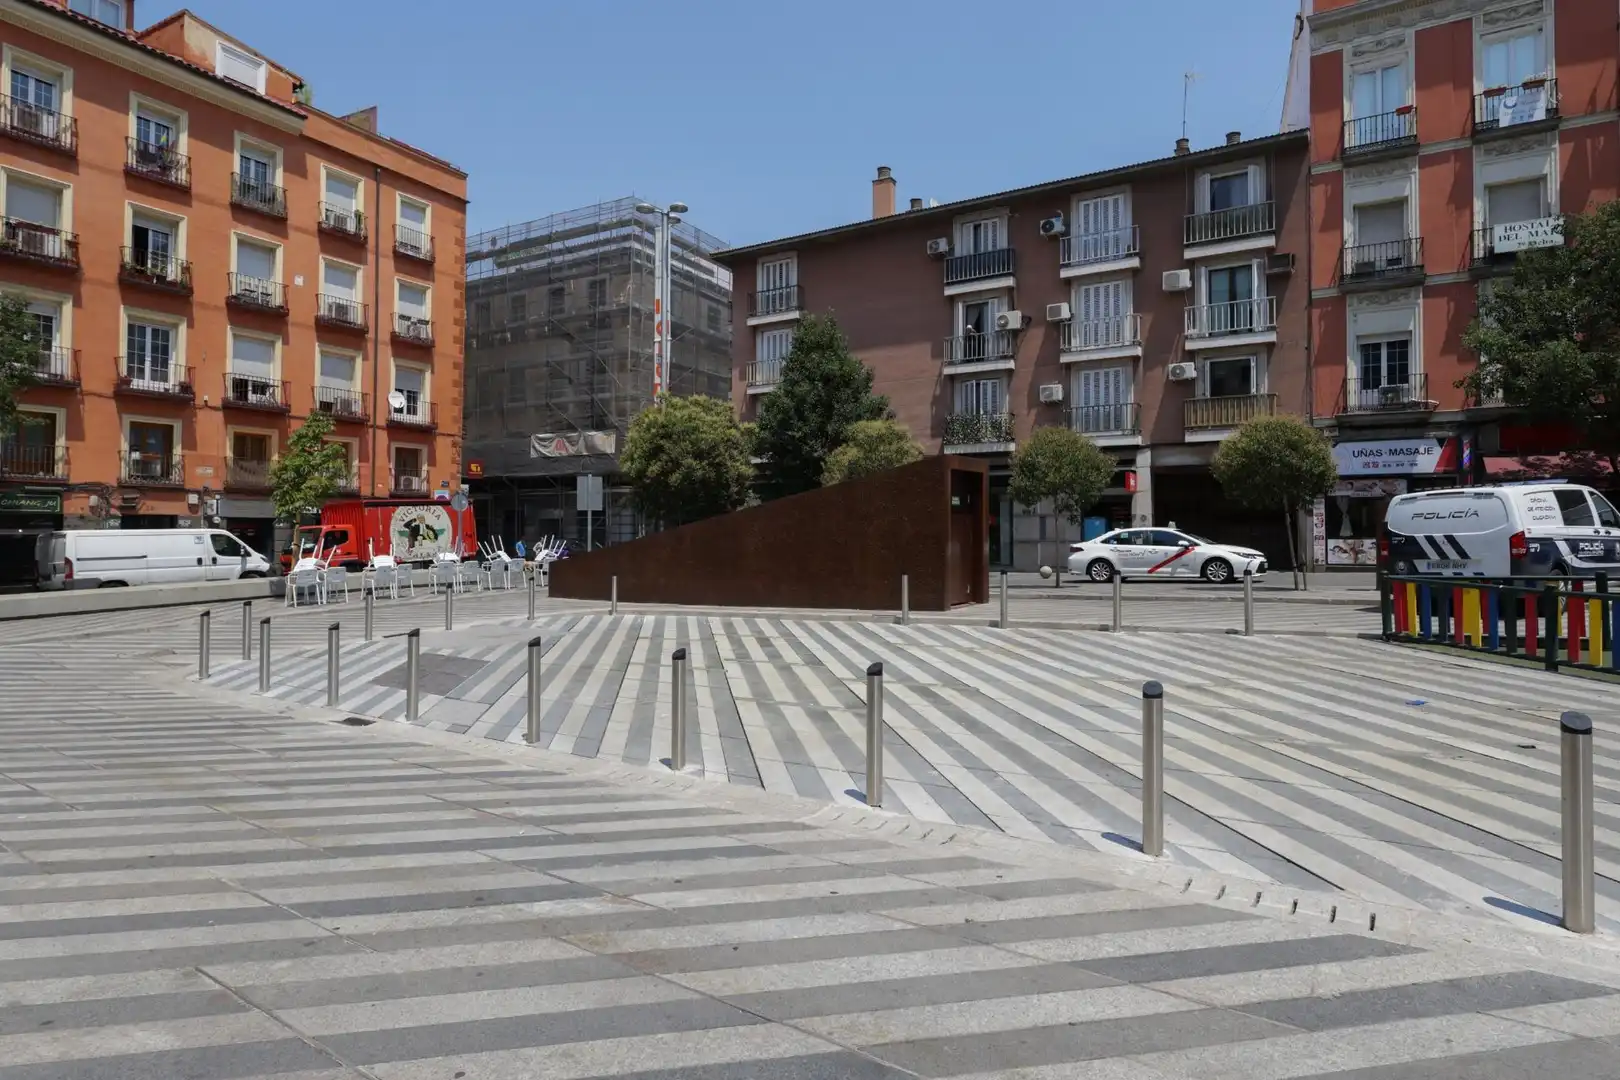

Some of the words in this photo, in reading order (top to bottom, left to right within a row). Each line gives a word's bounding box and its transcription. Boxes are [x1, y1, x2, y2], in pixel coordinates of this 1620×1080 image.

[1499, 232, 1523, 242] DEL
[1352, 447, 1384, 458] UÑAS
[1388, 445, 1435, 457] MASAJE
[399, 504, 442, 523] VICTORIA
[1411, 508, 1480, 520] POLICÍA
